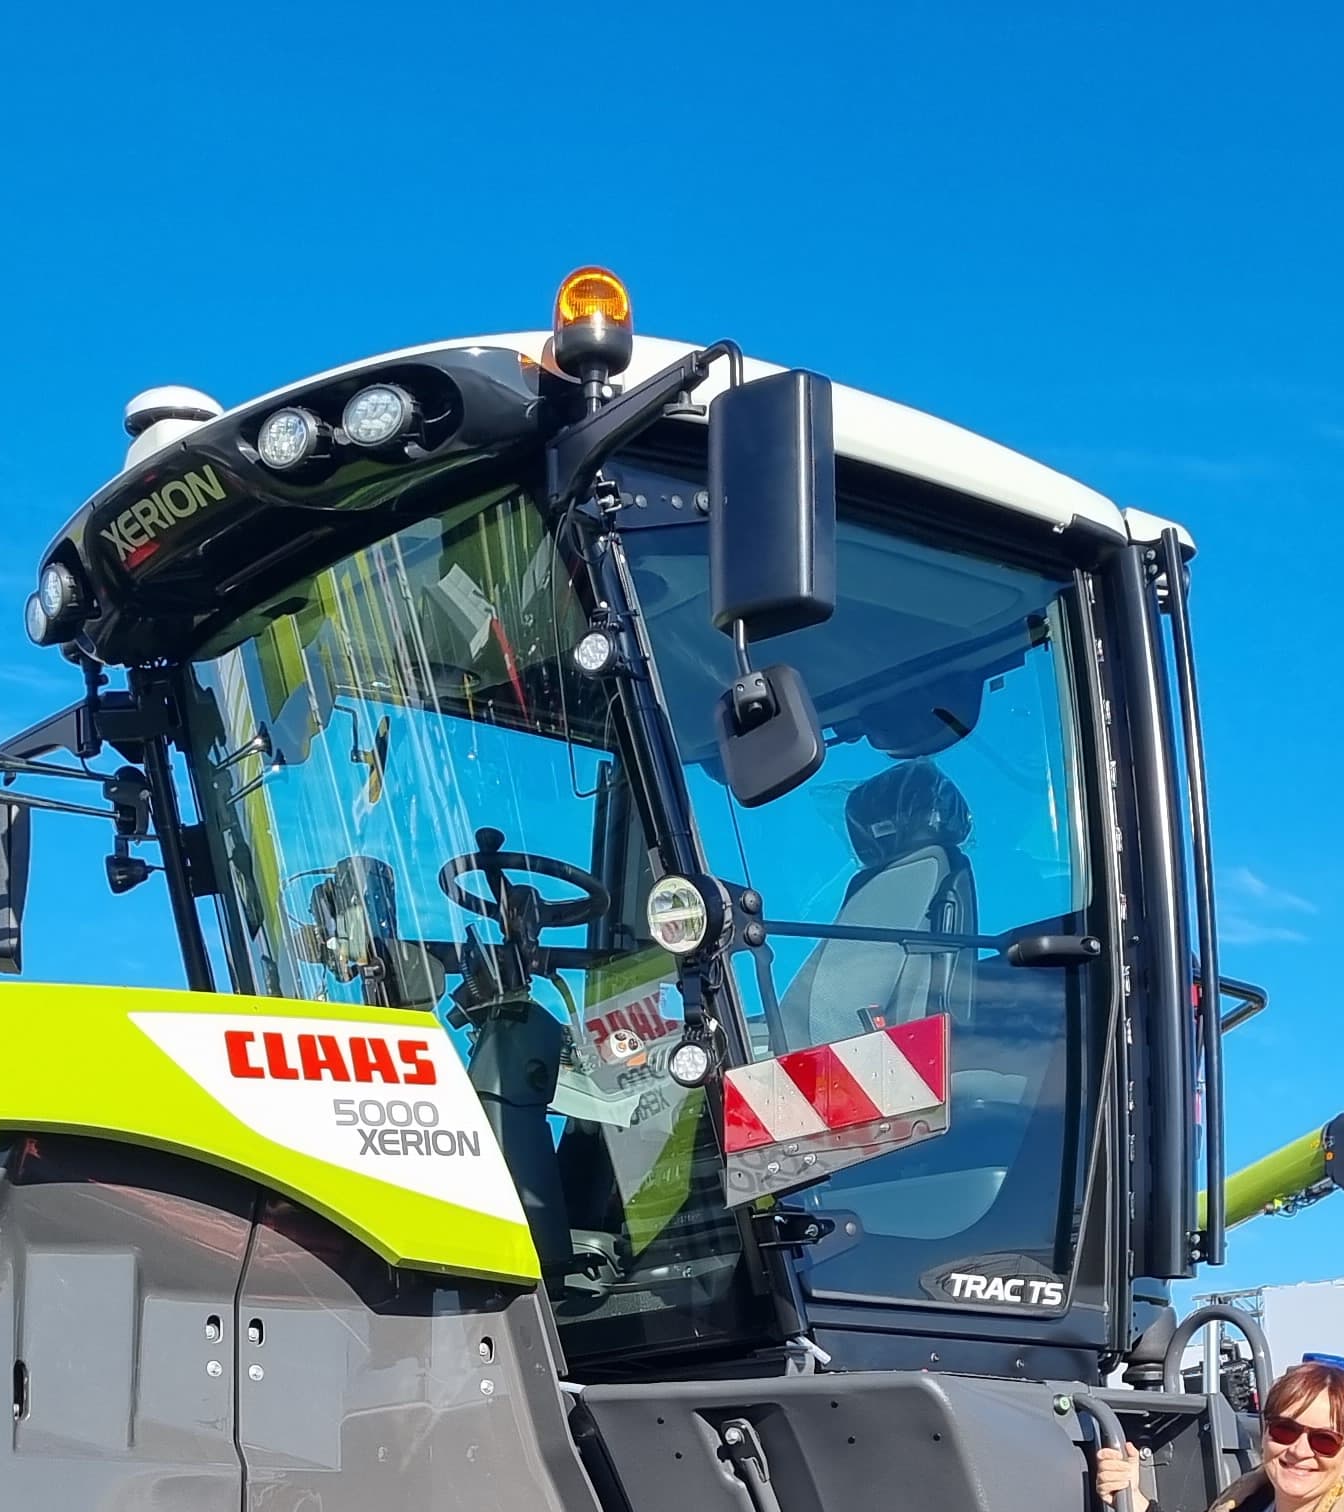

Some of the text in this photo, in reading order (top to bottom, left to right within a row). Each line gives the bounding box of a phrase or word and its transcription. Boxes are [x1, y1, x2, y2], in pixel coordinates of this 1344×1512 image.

[100, 464, 227, 561] XERION
[223, 1030, 436, 1085] CLAAS
[333, 1099, 440, 1127] 5000
[359, 1129, 481, 1157] XERION
[950, 1273, 1064, 1307] TRAC TS
